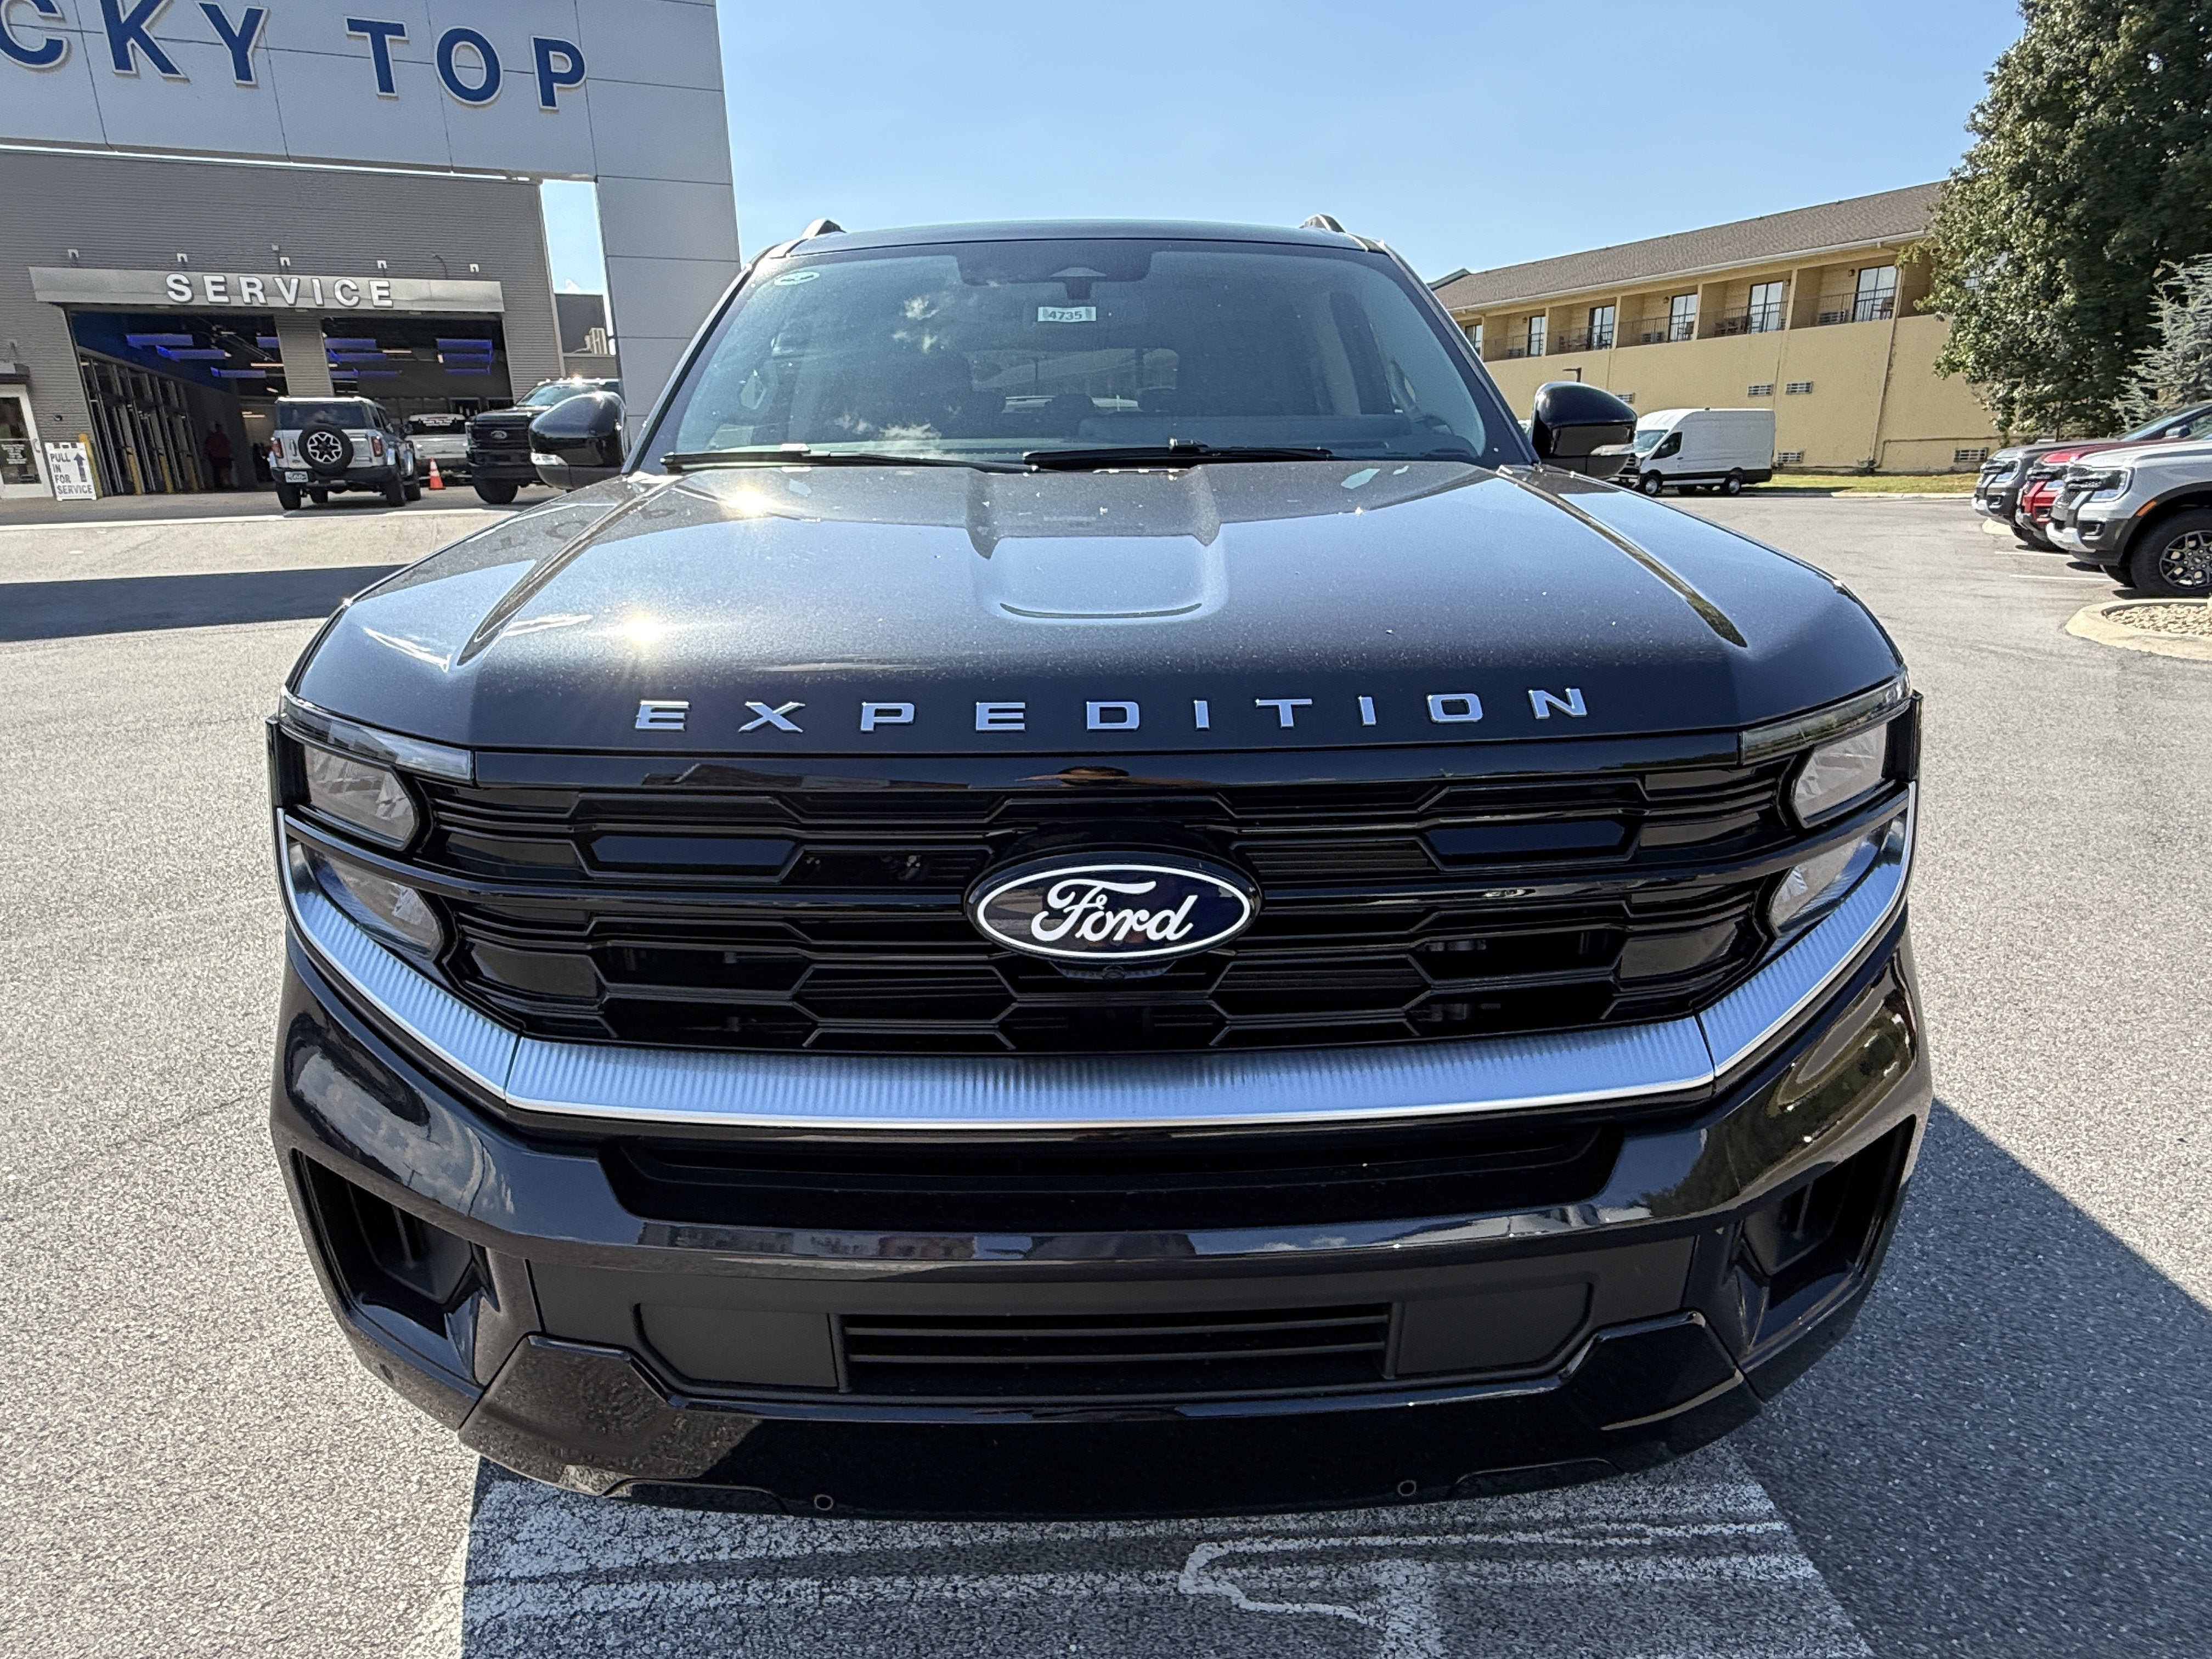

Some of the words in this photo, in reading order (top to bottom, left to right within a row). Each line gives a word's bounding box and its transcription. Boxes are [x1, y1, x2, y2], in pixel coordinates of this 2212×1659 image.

[345, 15, 588, 110] TOP
[166, 274, 393, 307] SERVICE
[1048, 311, 1082, 320] 4735
[50, 453, 71, 462] PULL
[52, 464, 61, 473] IN
[54, 474, 71, 483] FOR
[57, 486, 93, 494] SERVICE
[635, 688, 1587, 732] EXPEDITION
[1031, 879, 1198, 941] Ford
